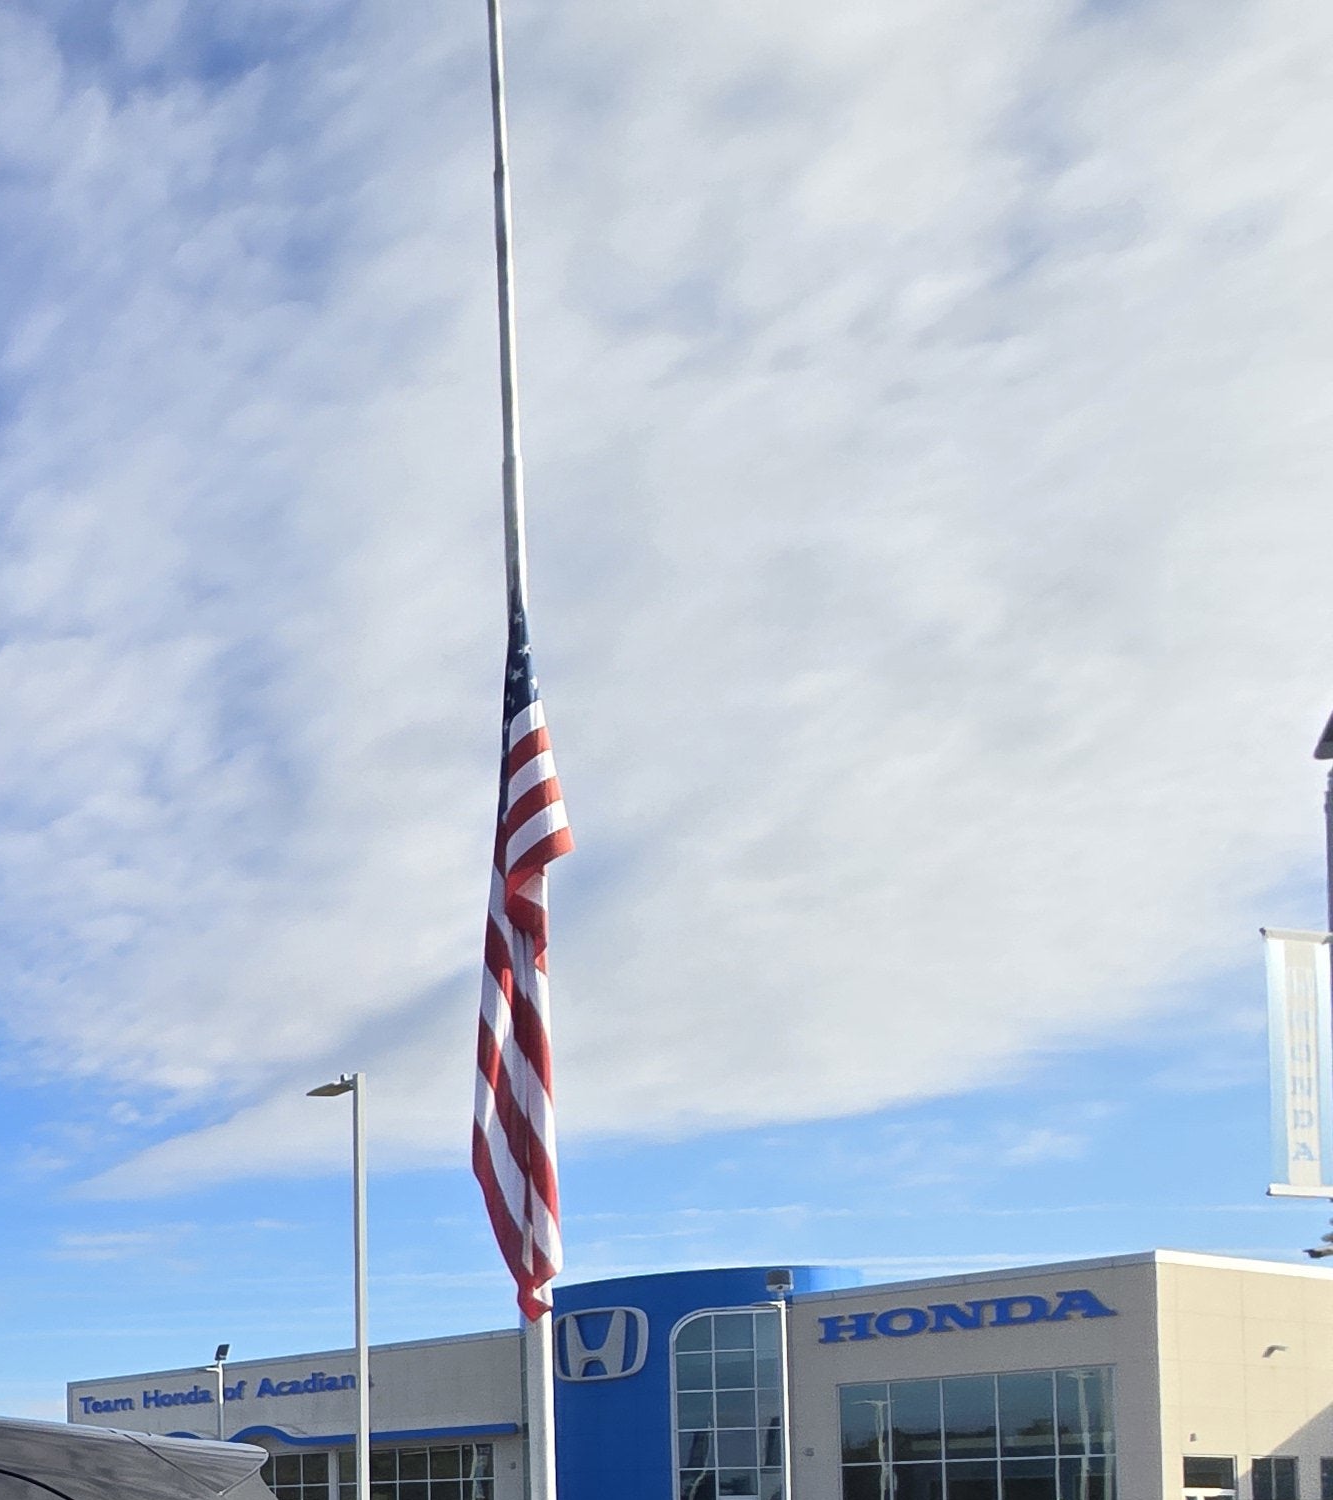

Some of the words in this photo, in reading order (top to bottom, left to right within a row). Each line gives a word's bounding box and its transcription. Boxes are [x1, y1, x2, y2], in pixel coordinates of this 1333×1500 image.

[817, 1289, 1118, 1344] HONDA
[79, 1395, 134, 1415] Team
[142, 1384, 214, 1410] Honda
[224, 1381, 248, 1402] of
[256, 1371, 375, 1399] Acadian
